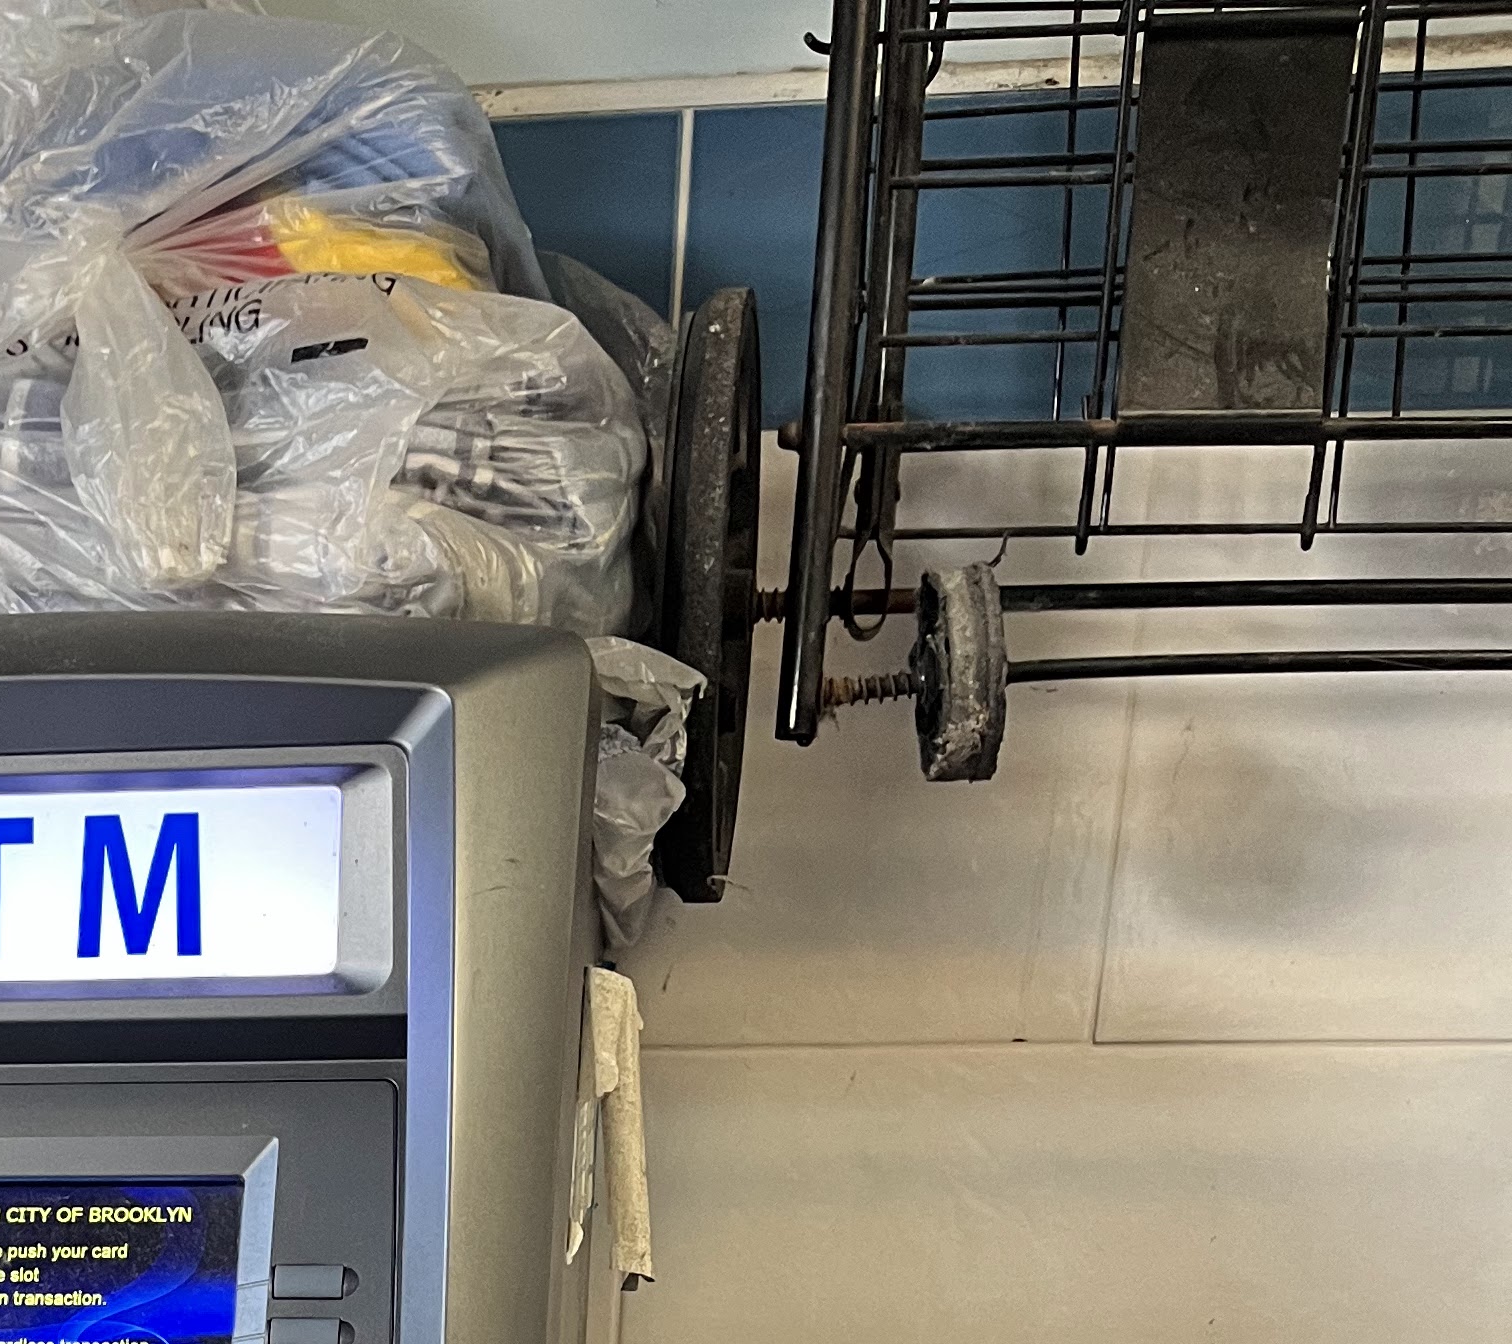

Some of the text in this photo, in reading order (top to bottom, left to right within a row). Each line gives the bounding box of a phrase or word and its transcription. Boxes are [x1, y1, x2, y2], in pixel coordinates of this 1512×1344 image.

[6, 1206, 52, 1223] CITY
[55, 1206, 84, 1223] OF
[88, 1206, 192, 1223] BROOKLYN
[7, 1243, 47, 1262] push
[51, 1245, 88, 1262] your
[91, 1243, 128, 1259] card
[9, 1267, 40, 1283] slot
[12, 1290, 107, 1307] transaction.
